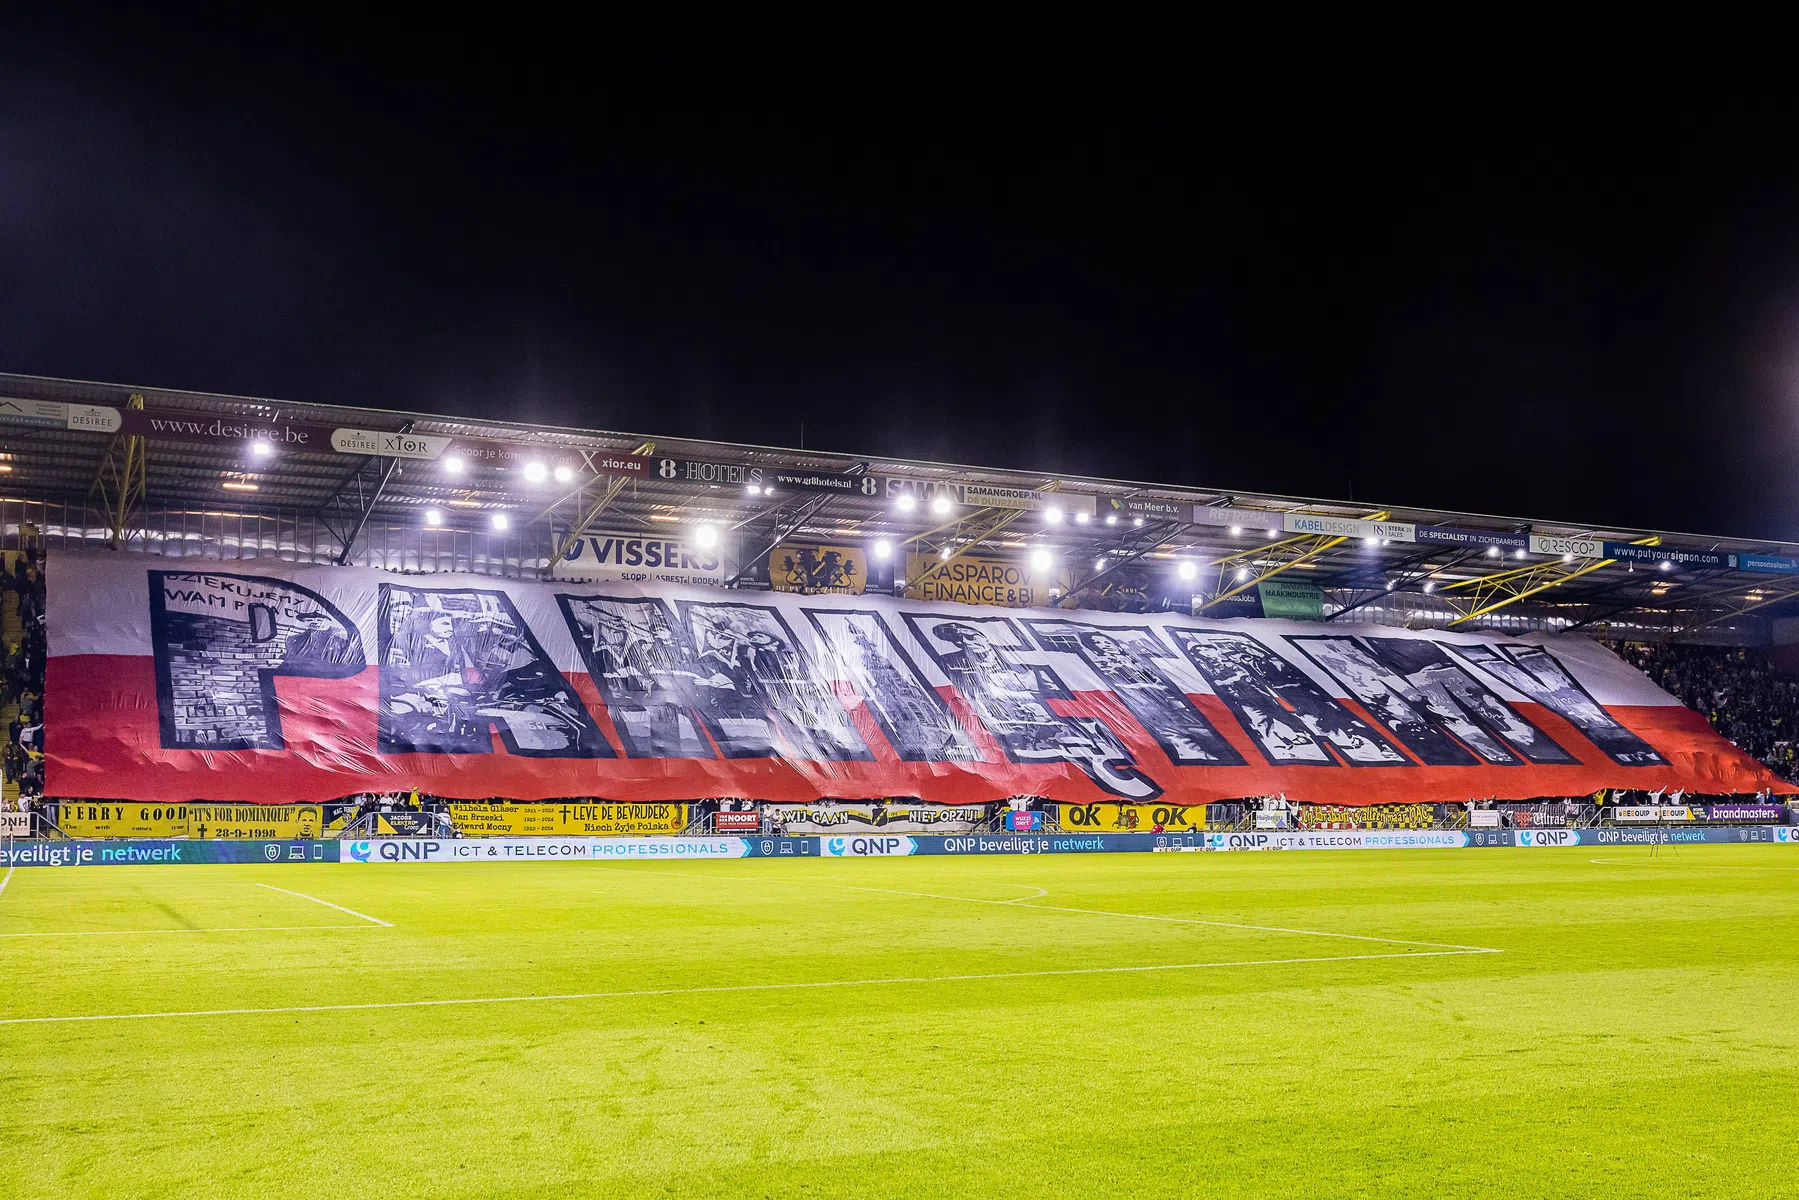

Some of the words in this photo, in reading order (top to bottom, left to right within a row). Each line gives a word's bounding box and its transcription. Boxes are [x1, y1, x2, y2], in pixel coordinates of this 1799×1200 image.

[151, 418, 309, 444] www.desiree.be
[384, 435, 428, 454] XIOR
[454, 445, 484, 457] Scoor
[486, 448, 496, 459] je
[498, 450, 526, 460] kame
[602, 458, 641, 470] xior.eu
[686, 461, 763, 485] HOTELS
[777, 474, 852, 489] www.gr8hotels.nl
[887, 479, 965, 503] SAMAN
[967, 486, 1043, 500] SAMANGROEP.NL
[967, 496, 979, 504] DE
[981, 497, 1032, 509] DUURZAME
[1128, 502, 1143, 511] van
[1144, 502, 1164, 512] Meer
[1166, 504, 1179, 513] b.v.
[1294, 519, 1360, 534] KABELDESIGN
[1419, 530, 1428, 538] DE
[1429, 531, 1469, 542] SPECIALIST
[1478, 535, 1526, 547] ZICHTBAARHEID
[589, 537, 719, 571] VISSERS
[1613, 546, 1719, 564] www.putyoursignon.com
[692, 576, 719, 586] BODEM
[923, 561, 1032, 586] KASPAROV
[164, 588, 226, 608] WAM
[923, 581, 1003, 602] FINANCE
[1265, 589, 1320, 600] MAAKINDUSTRIE
[64, 806, 124, 821] FERRY
[140, 805, 187, 821] GOOD
[214, 807, 233, 822] FOR
[453, 804, 488, 812] Wilhelm
[573, 805, 598, 821] LEVE
[601, 806, 613, 820] DE
[616, 804, 670, 820] BEVRIJDERS
[1314, 805, 1350, 823] Brabant
[1408, 803, 1430, 826] NAC
[1712, 807, 1779, 820] brandmasters.
[453, 813, 469, 821] Jan
[471, 814, 504, 822] Brzeski
[728, 814, 757, 822] NOORT
[782, 810, 808, 823] WIJ
[811, 811, 849, 825] GAAN
[908, 810, 938, 823] NIET
[939, 809, 979, 822] OPZIJ!
[1068, 806, 1101, 826] OK
[1151, 806, 1188, 826] OK
[1533, 811, 1566, 825] Ultras
[215, 828, 277, 838] 28-9-1998
[452, 822, 485, 831] Edward
[486, 823, 513, 832] Mocny
[584, 822, 613, 832] Niech
[637, 821, 669, 831] Polska
[943, 838, 976, 852] QNP
[979, 836, 1035, 854] beveiligt
[1036, 836, 1049, 854] je
[1053, 836, 1104, 850] netwerk
[1229, 834, 1268, 848] QNP
[1276, 837, 1295, 846] ICT
[1298, 837, 1306, 846] &
[1308, 837, 1362, 846] TELECOM
[1364, 836, 1455, 845] PROFESSIONALS
[1536, 831, 1568, 846] QNP
[1597, 830, 1620, 843] QNP
[1621, 830, 1659, 845] beveiligt
[1659, 830, 1668, 845] je
[1670, 830, 1706, 842] netwerk
[75, 844, 94, 866] je
[101, 843, 182, 861] netwerk
[379, 841, 441, 862] QNP
[453, 845, 482, 857] ICT
[487, 845, 498, 857] &
[504, 845, 586, 857] TELECOM
[592, 843, 729, 855] PROFESSIONALS
[852, 838, 900, 856] QNP
